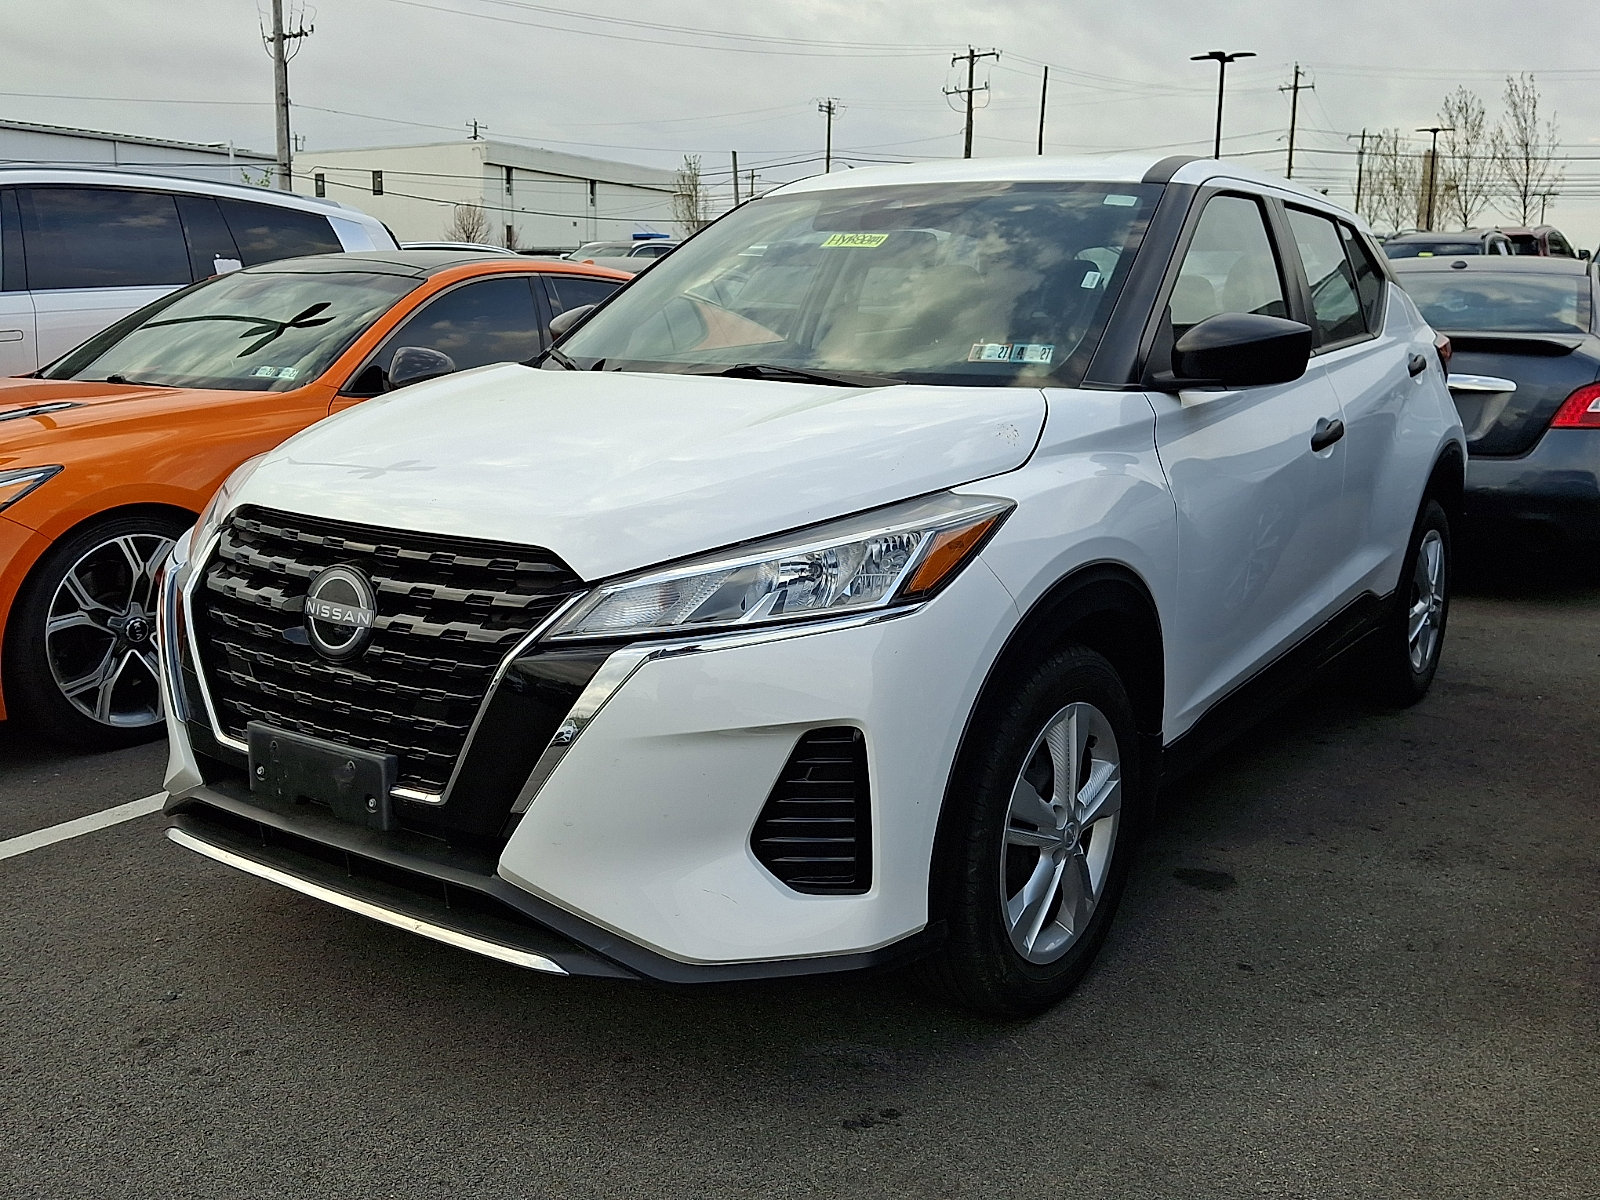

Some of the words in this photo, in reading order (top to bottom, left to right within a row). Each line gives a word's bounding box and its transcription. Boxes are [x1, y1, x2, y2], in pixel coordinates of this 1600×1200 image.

[997, 346, 1009, 359] 27
[1016, 346, 1025, 360] 4
[1040, 347, 1051, 361] 27
[306, 600, 370, 625] NISSAN
[133, 621, 143, 640] KIA
